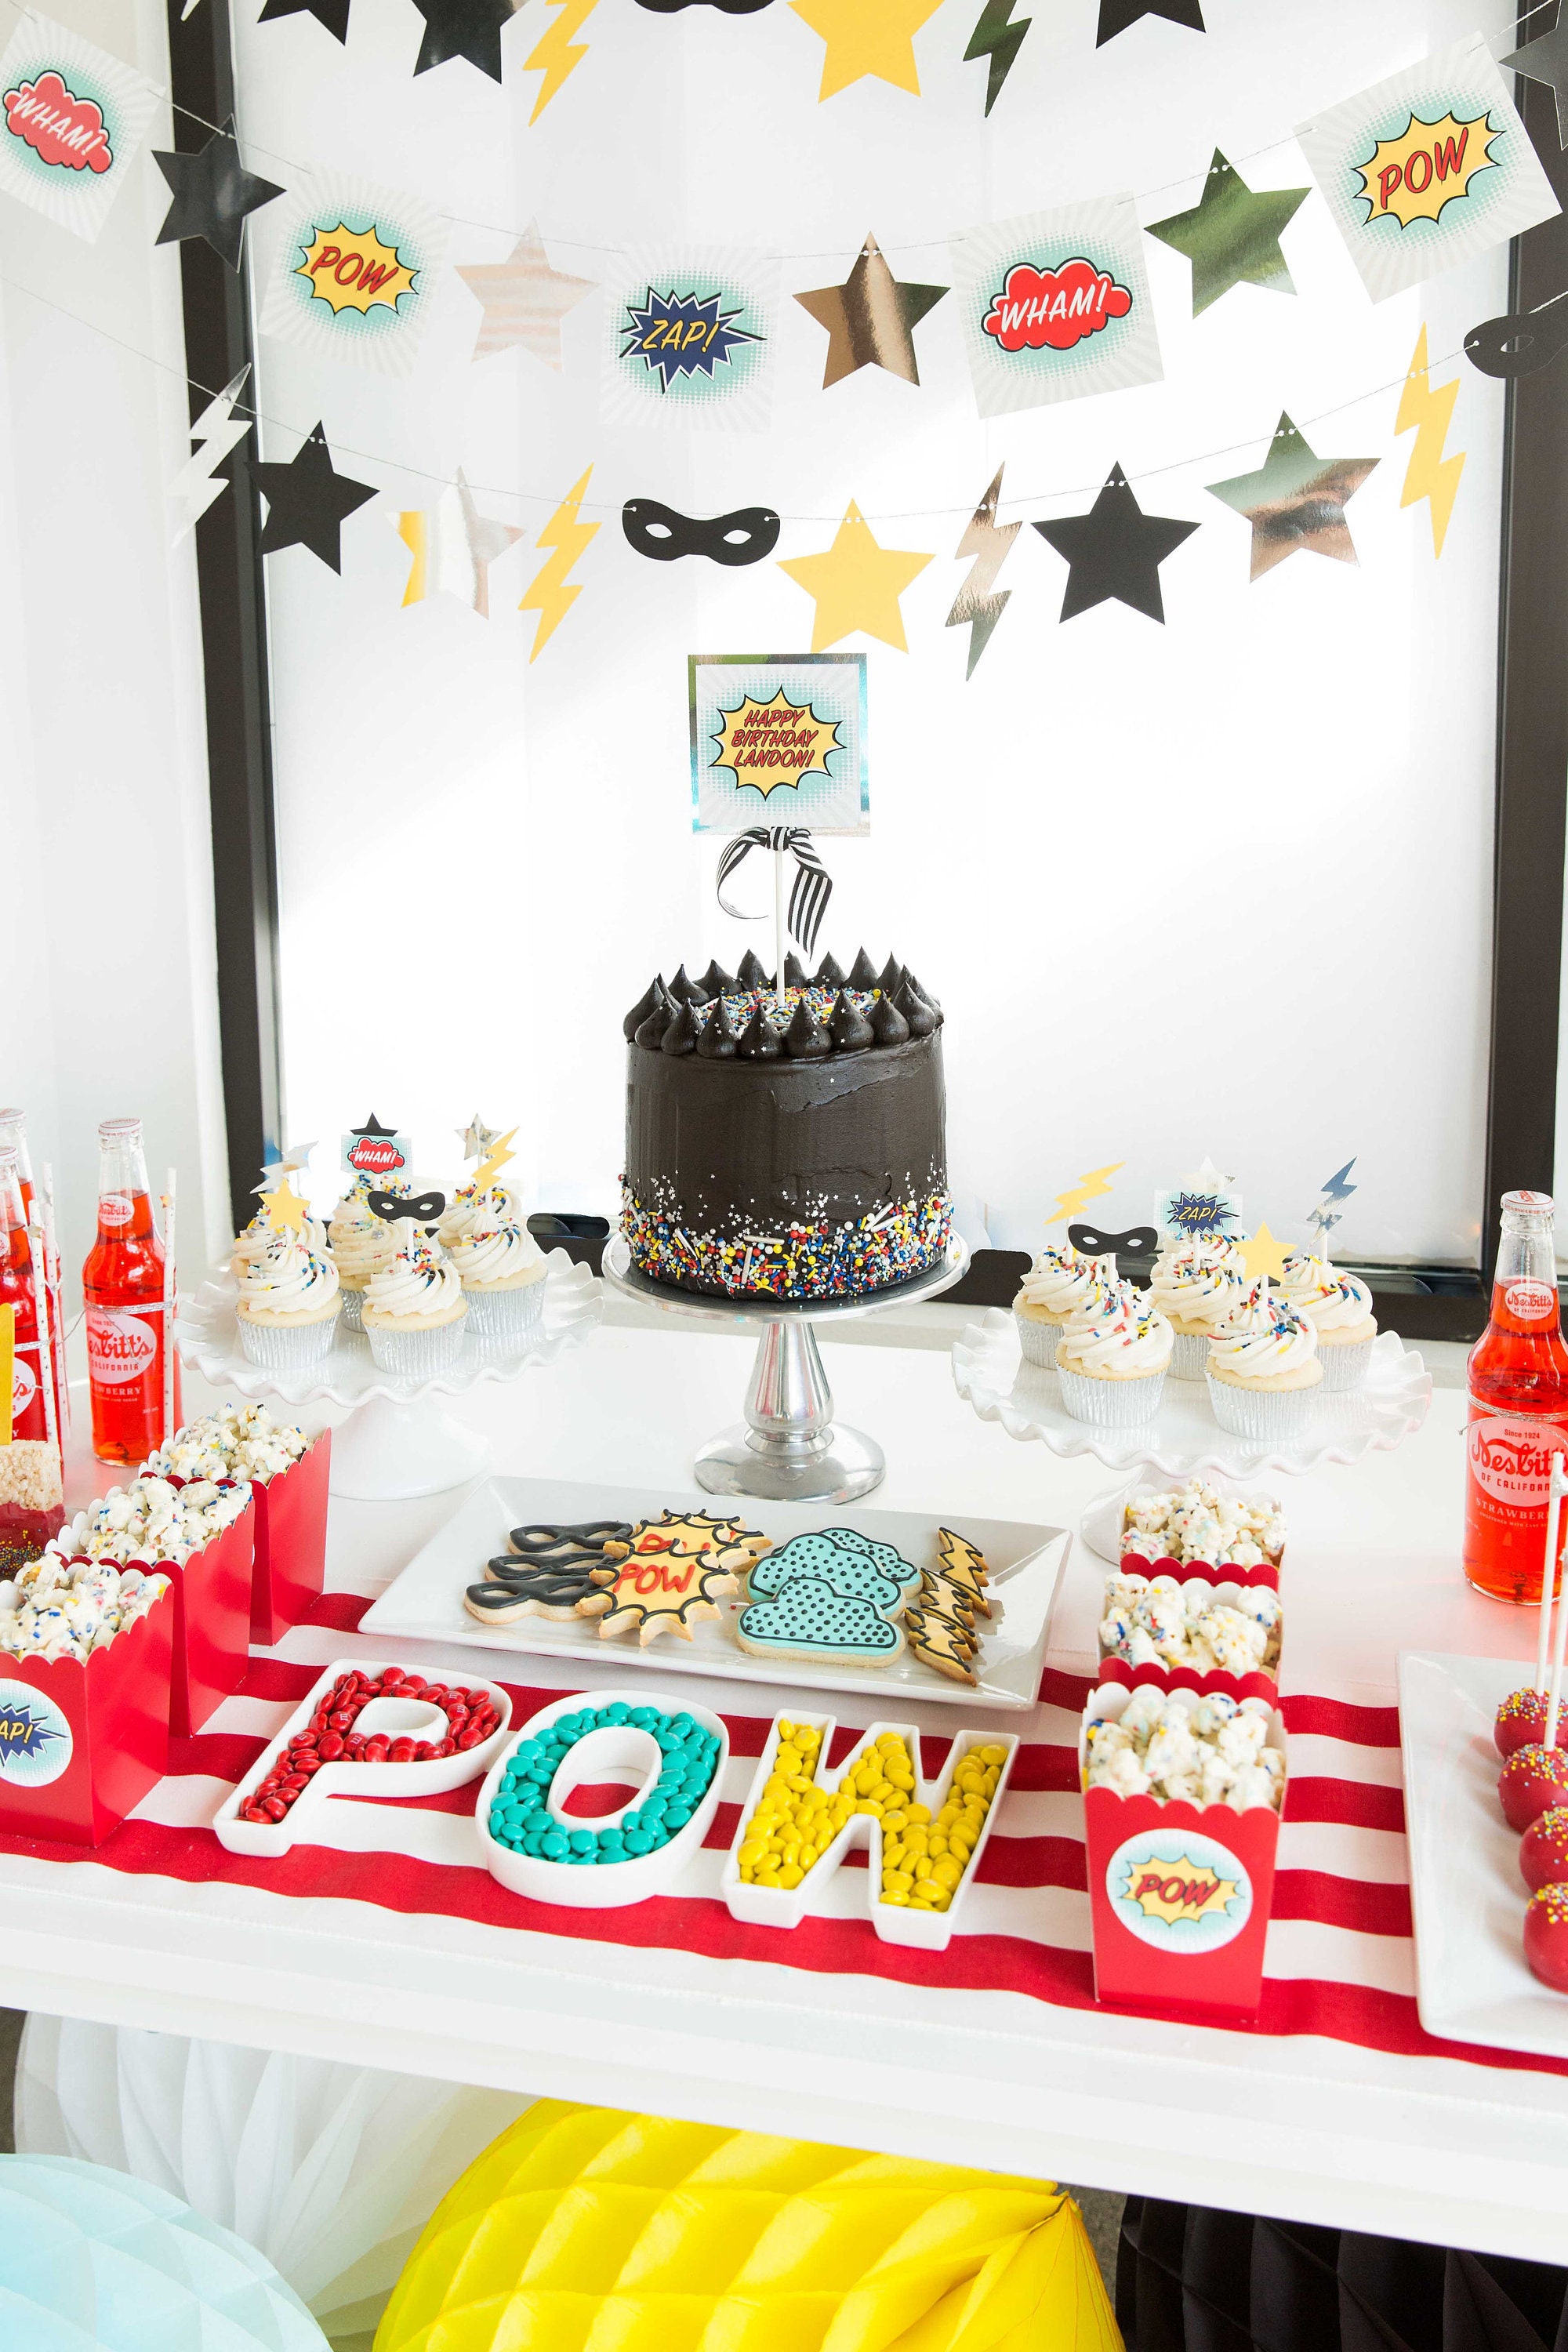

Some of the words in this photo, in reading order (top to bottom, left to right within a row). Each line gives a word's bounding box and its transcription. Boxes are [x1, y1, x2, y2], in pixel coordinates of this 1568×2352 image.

[13, 92, 103, 156] WHAM!
[1377, 126, 1469, 210] POW
[310, 246, 399, 295] POW
[1000, 280, 1108, 333] WHAM!
[641, 318, 720, 353] ZAP!
[743, 709, 806, 728] HAPPY
[731, 729, 819, 748] BIRTHDAY
[733, 749, 815, 768] LANDON!
[354, 1150, 397, 1163] WHAM!
[1178, 1207, 1218, 1222] ZAP!
[1504, 1428, 1523, 1439] Since
[1481, 1472, 1492, 1483] OF
[612, 1563, 695, 1595] POW
[1135, 1874, 1220, 1907] POW
